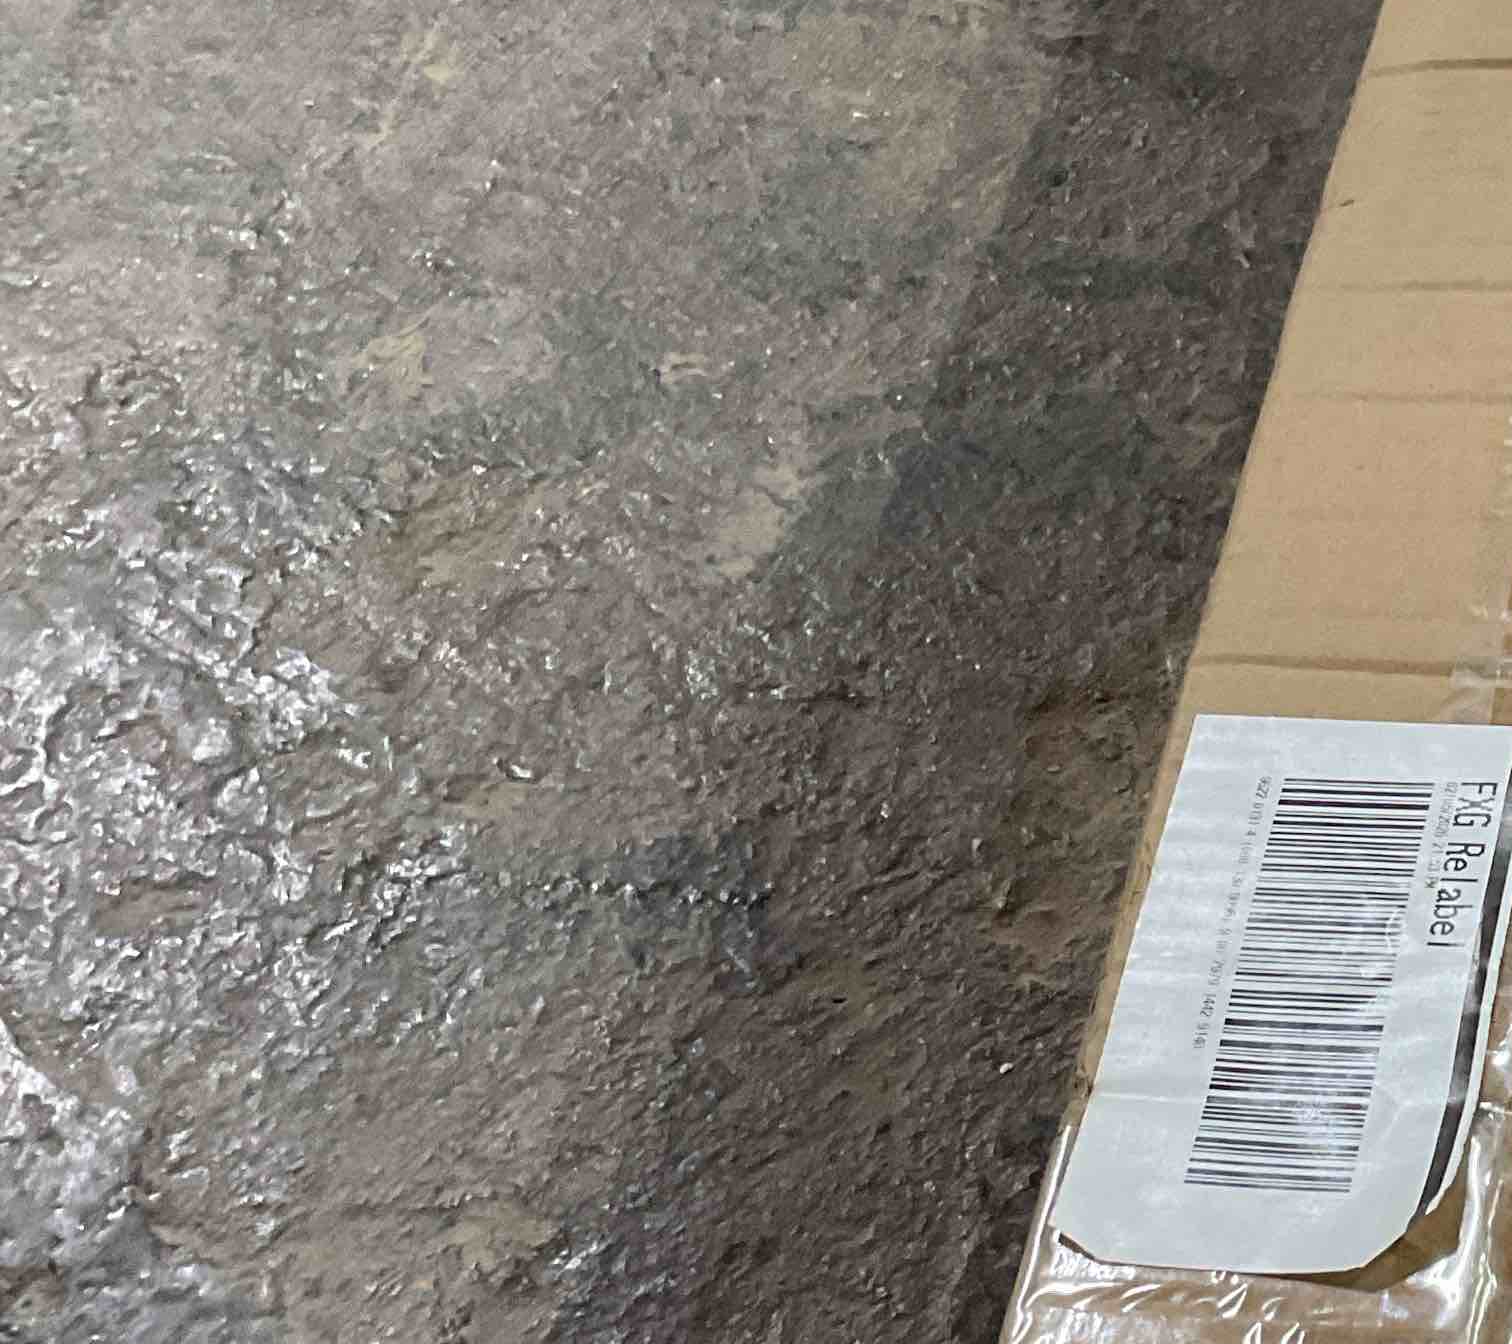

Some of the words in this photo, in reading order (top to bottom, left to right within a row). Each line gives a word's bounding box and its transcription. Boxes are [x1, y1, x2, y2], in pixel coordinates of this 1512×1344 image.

[1450, 782, 1498, 828] FXG
[1426, 842, 1487, 947] Relabel
[1199, 992, 1217, 1017] 1442
